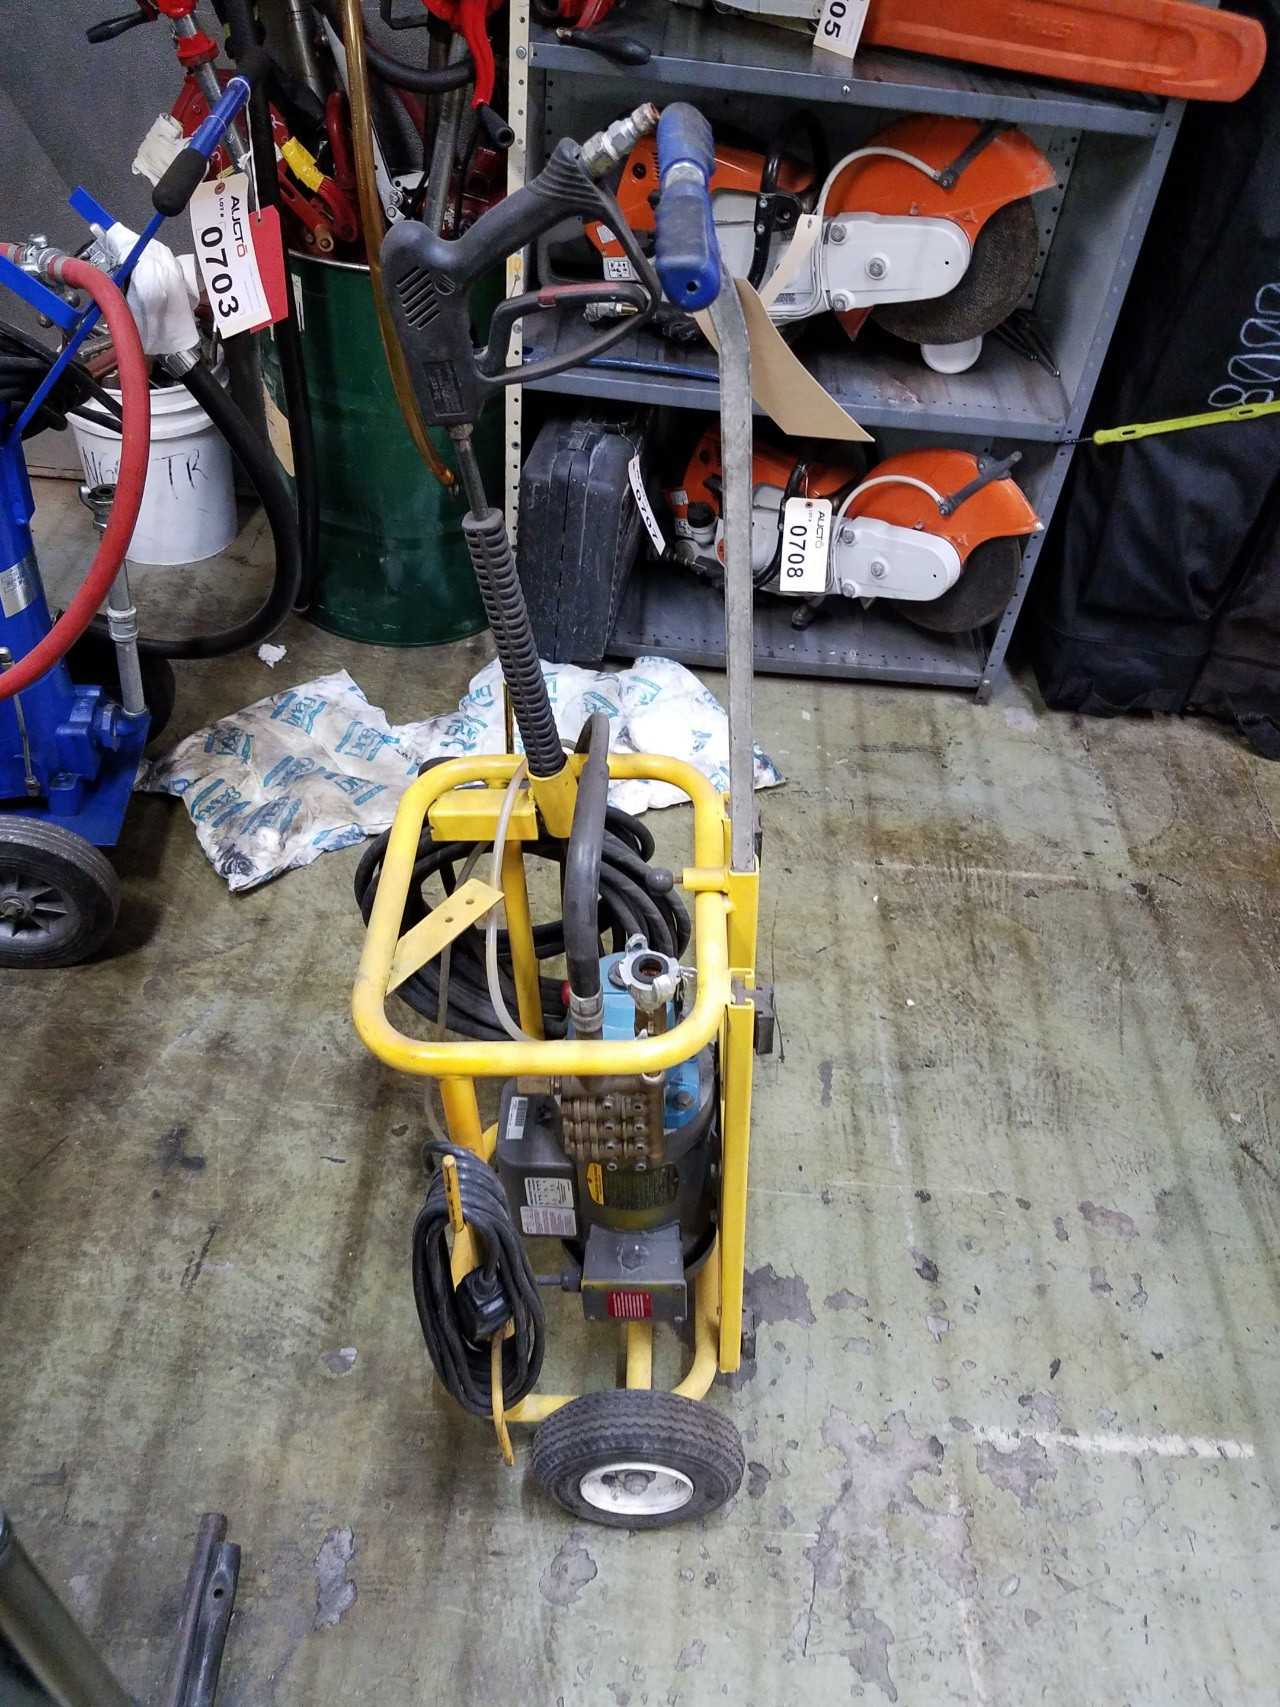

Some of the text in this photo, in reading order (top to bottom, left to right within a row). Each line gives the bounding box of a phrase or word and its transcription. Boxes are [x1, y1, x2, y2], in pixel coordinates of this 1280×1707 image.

[824, 0, 848, 38] 05
[200, 226, 239, 318] 0703
[786, 525, 808, 578] 0708
